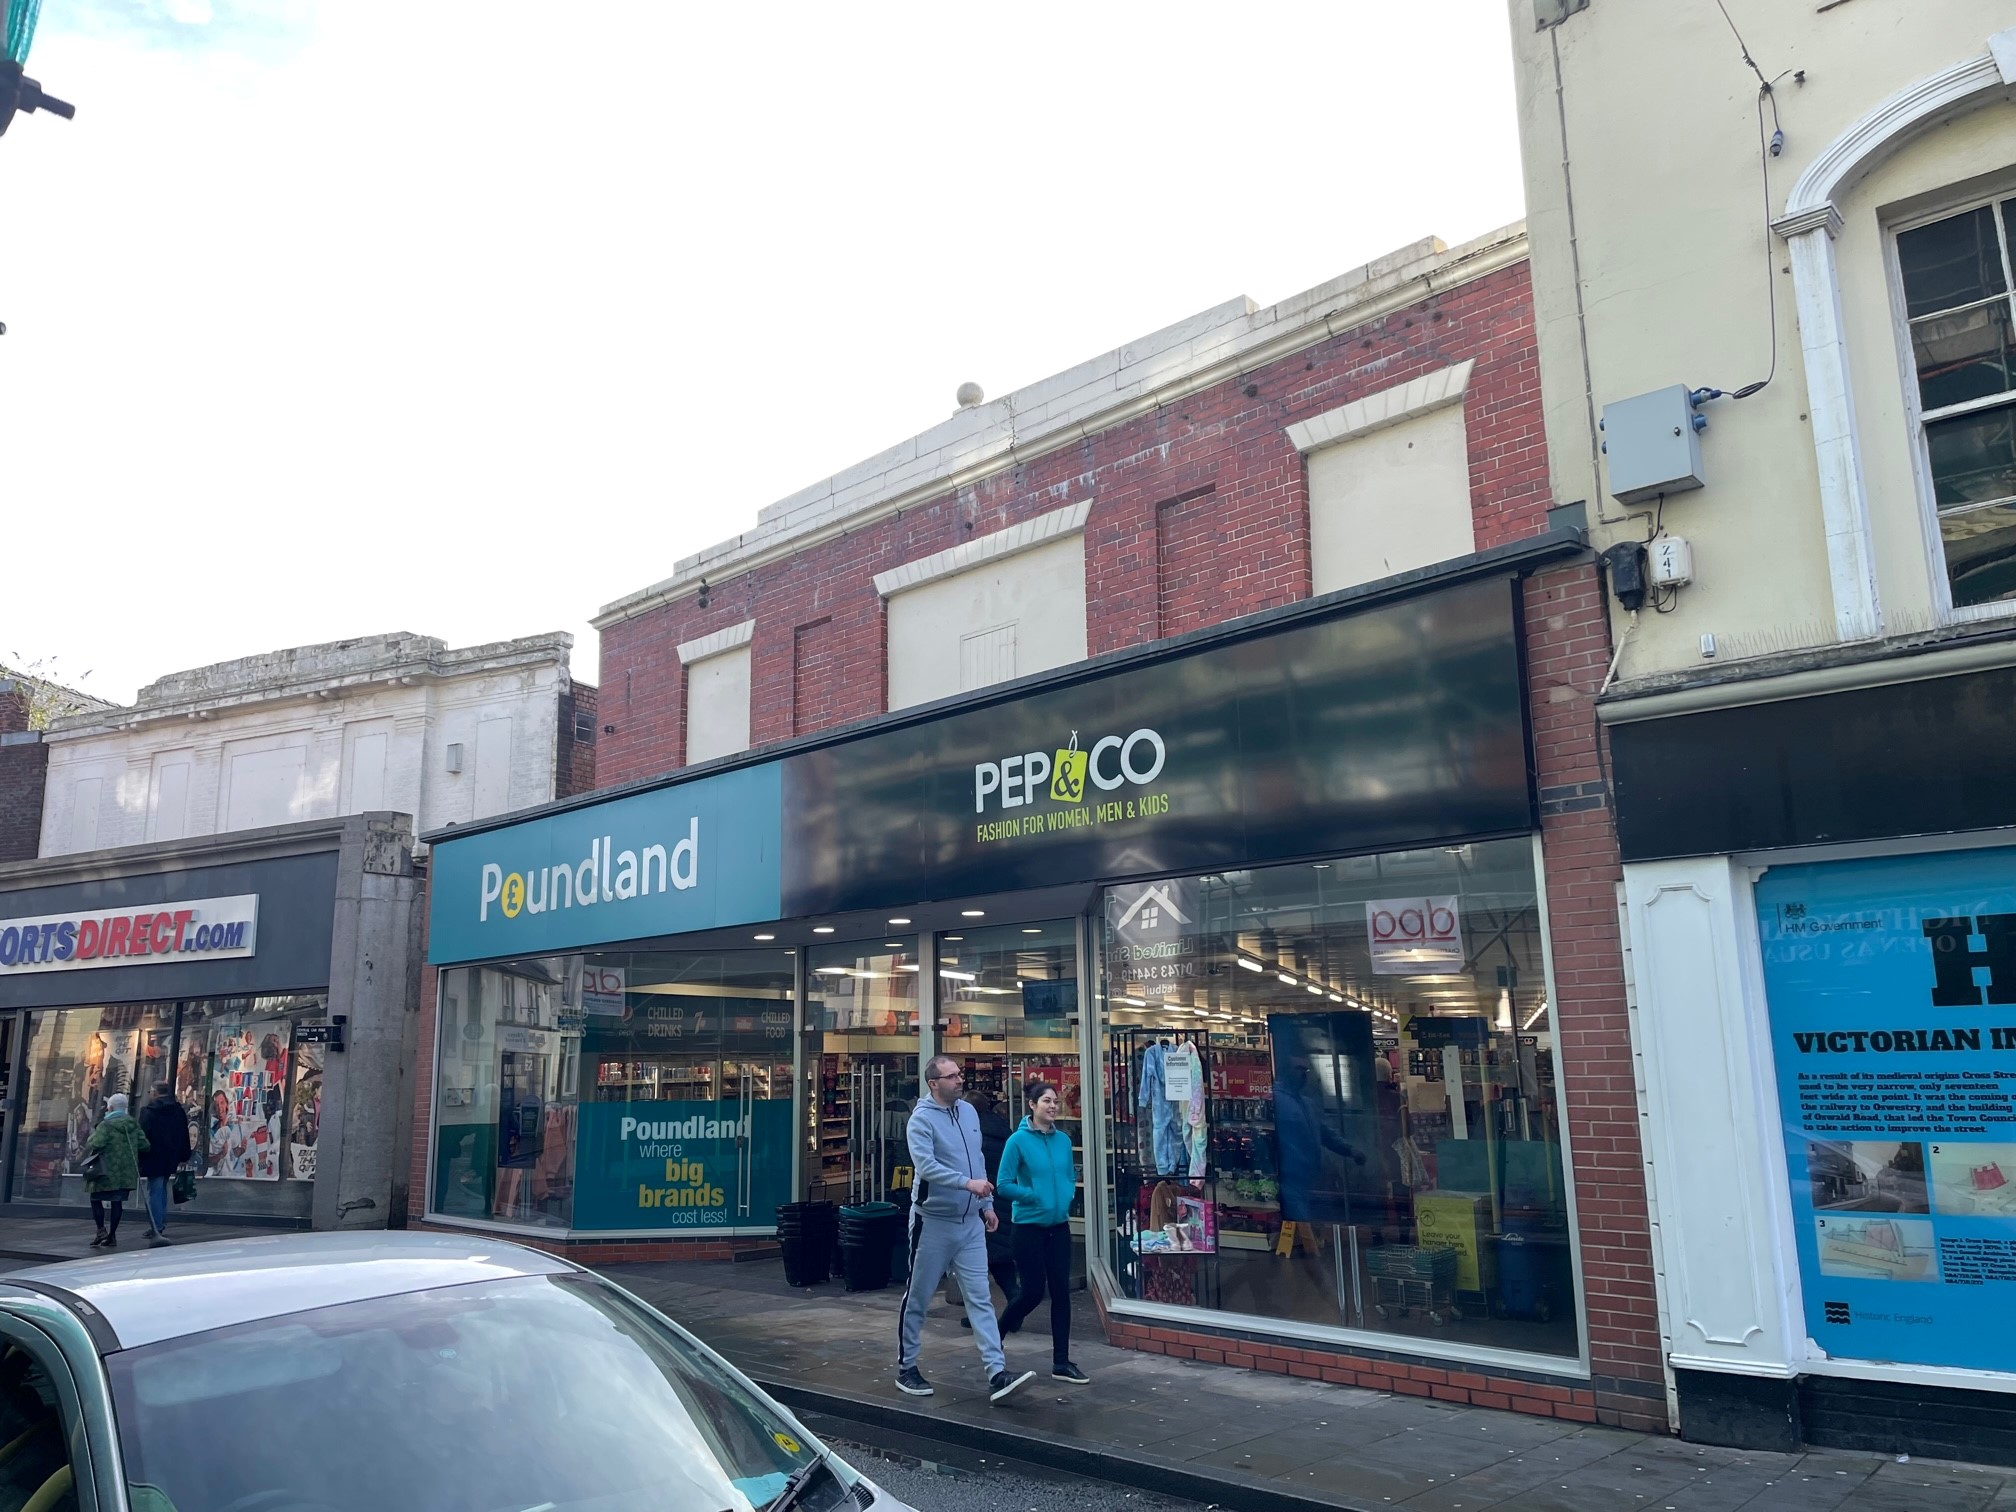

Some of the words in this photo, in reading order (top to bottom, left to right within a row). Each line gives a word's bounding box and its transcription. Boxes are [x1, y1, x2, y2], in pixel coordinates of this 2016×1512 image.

[975, 728, 1166, 813] PEP&CO
[977, 819, 1020, 843] FASHION
[1023, 814, 1044, 836] FOR
[1047, 806, 1093, 831] WOMEN,
[1097, 801, 1122, 822] MEN
[1126, 801, 1135, 818] &
[1139, 793, 1169, 816] KIDS
[1785, 923, 1805, 933] HM
[1810, 919, 1883, 932] Government
[648, 1007, 684, 1020] CHILLED
[761, 1012, 790, 1024] CHILLED
[648, 1024, 682, 1037] DRINKS
[765, 1027, 786, 1038] FOOD
[1793, 1028, 1981, 1053] VICTORIAN
[1210, 1070, 1228, 1091] £1
[1798, 1072, 1809, 1080] As
[1924, 1072, 1960, 1081] origins
[1919, 1083, 1941, 1091] only
[1968, 1093, 2008, 1102] coming
[1820, 1103, 1857, 1112] railway
[1873, 1103, 1923, 1112] Oswestry,
[1948, 1103, 1965, 1111] the
[1968, 1103, 2012, 1113] building
[1853, 1114, 1881, 1122] Road,
[1946, 1114, 1976, 1122] Town
[621, 1115, 750, 1140] Poundland
[1887, 1124, 1931, 1133] improve
[640, 1141, 682, 1158] where
[666, 1158, 703, 1186] big
[638, 1183, 725, 1208] brands
[672, 1209, 697, 1224] cost
[701, 1208, 728, 1224] less!
[1422, 1231, 1443, 1239] Leave
[1446, 1233, 1461, 1242] your
[1422, 1239, 1448, 1248] hanger
[1449, 1240, 1465, 1248] here
[1894, 1313, 1933, 1325] England
